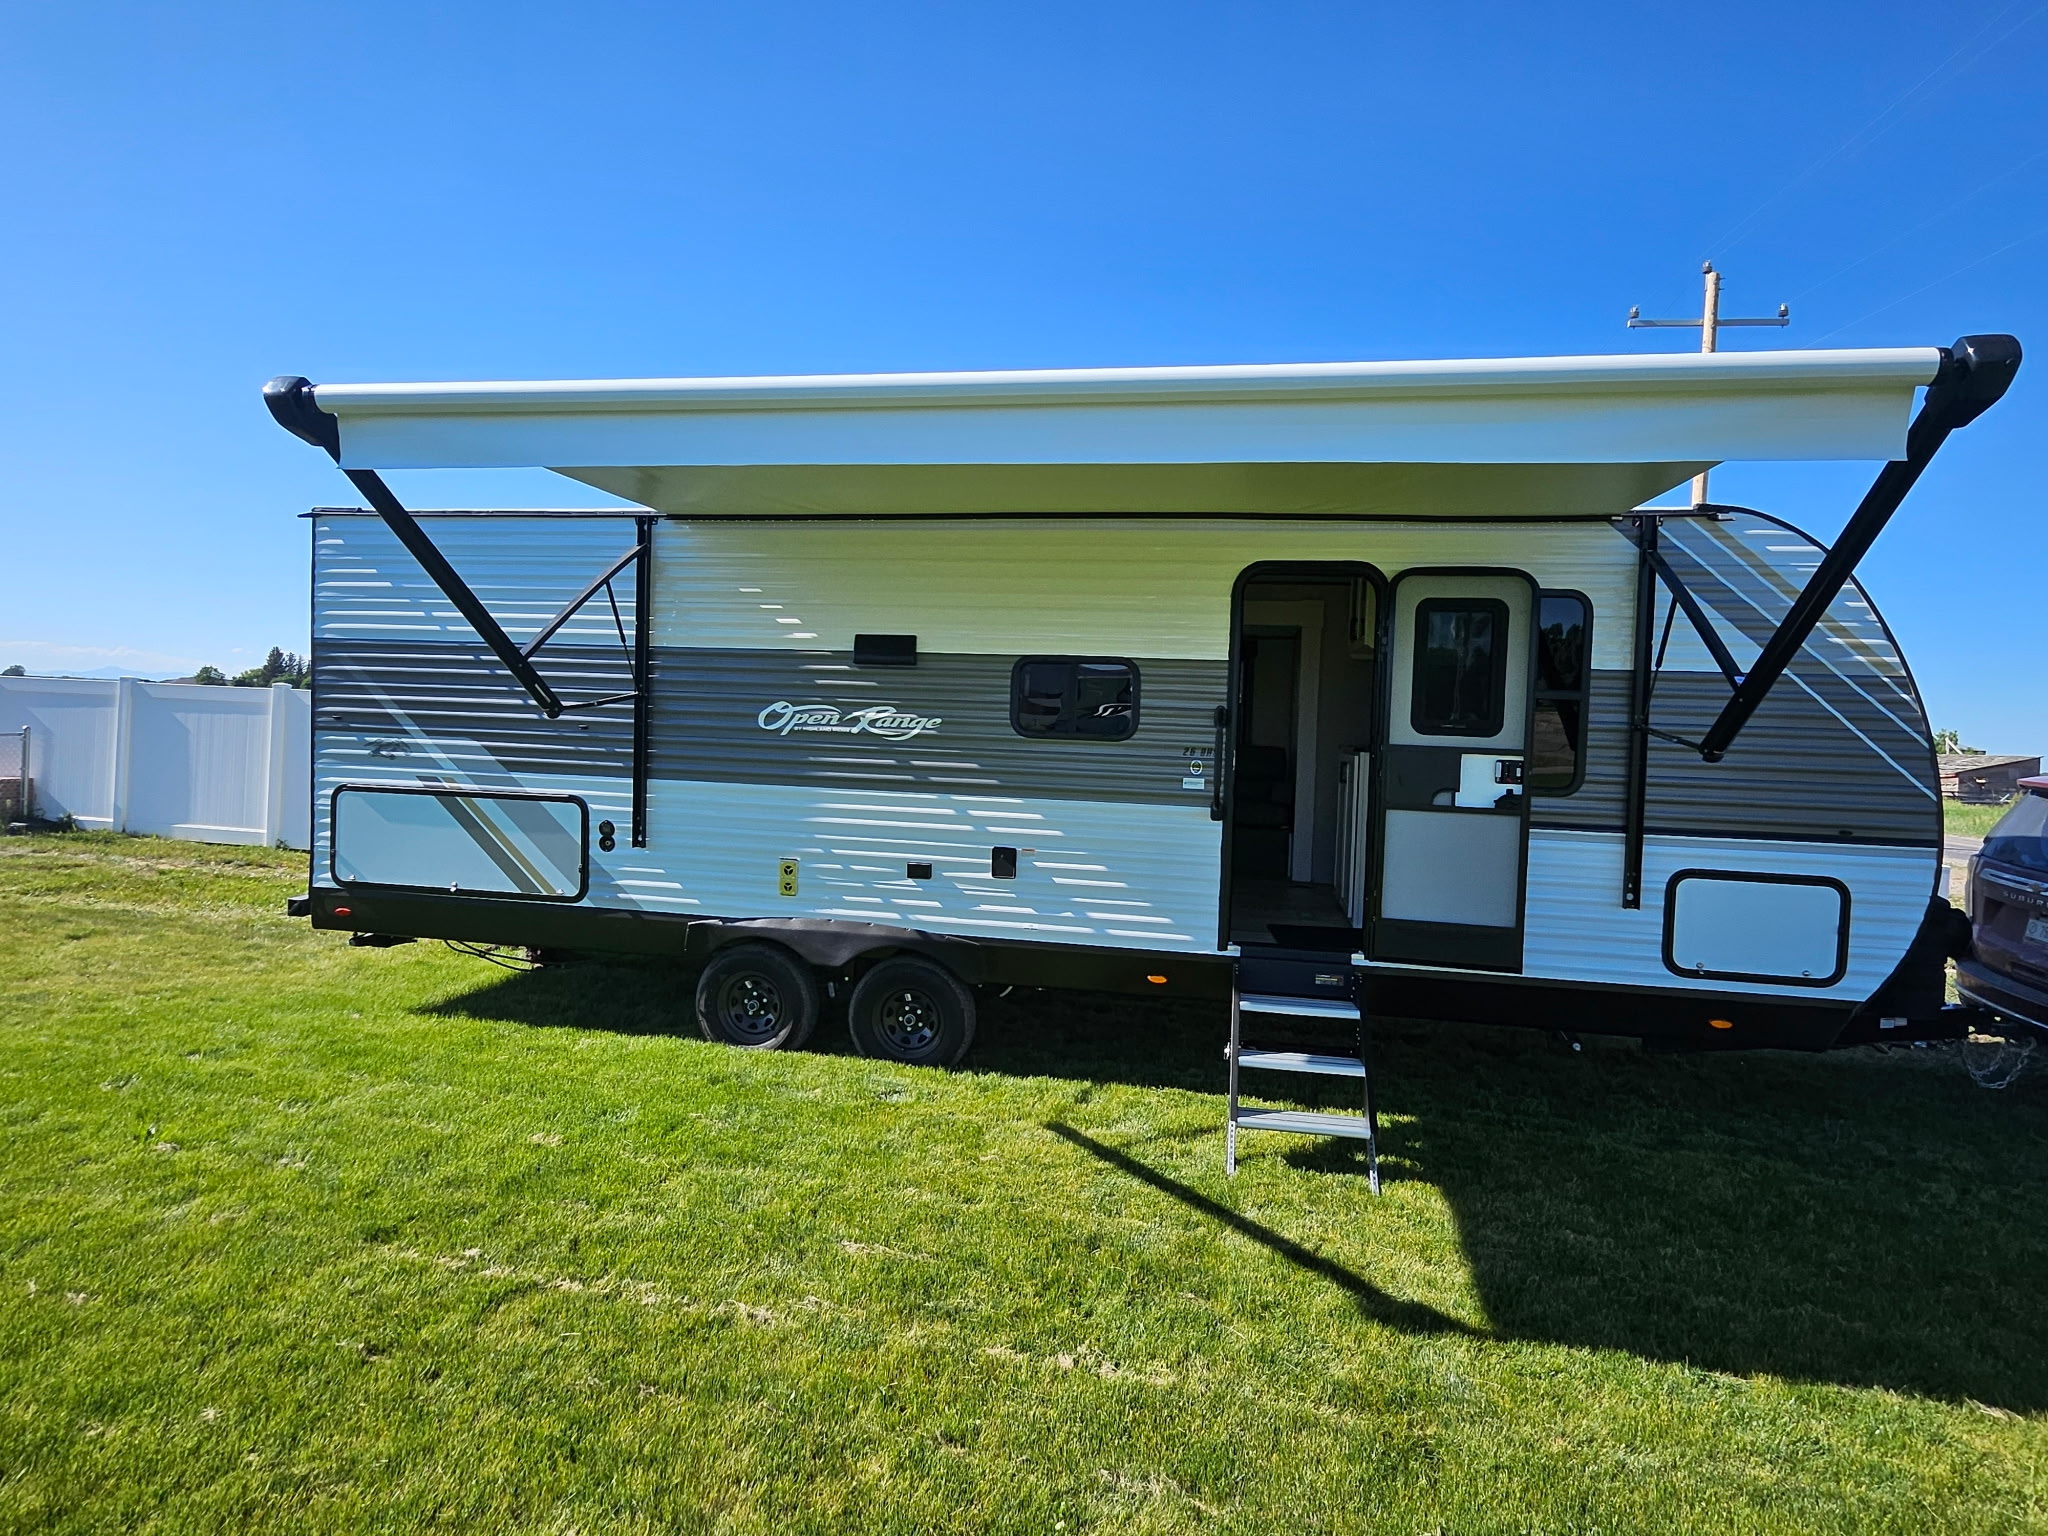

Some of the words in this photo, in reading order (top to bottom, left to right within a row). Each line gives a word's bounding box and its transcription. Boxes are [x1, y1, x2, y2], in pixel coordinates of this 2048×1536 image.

[758, 701, 842, 735] Open
[842, 706, 942, 740] Range
[2003, 890, 2048, 908] SUBUR
